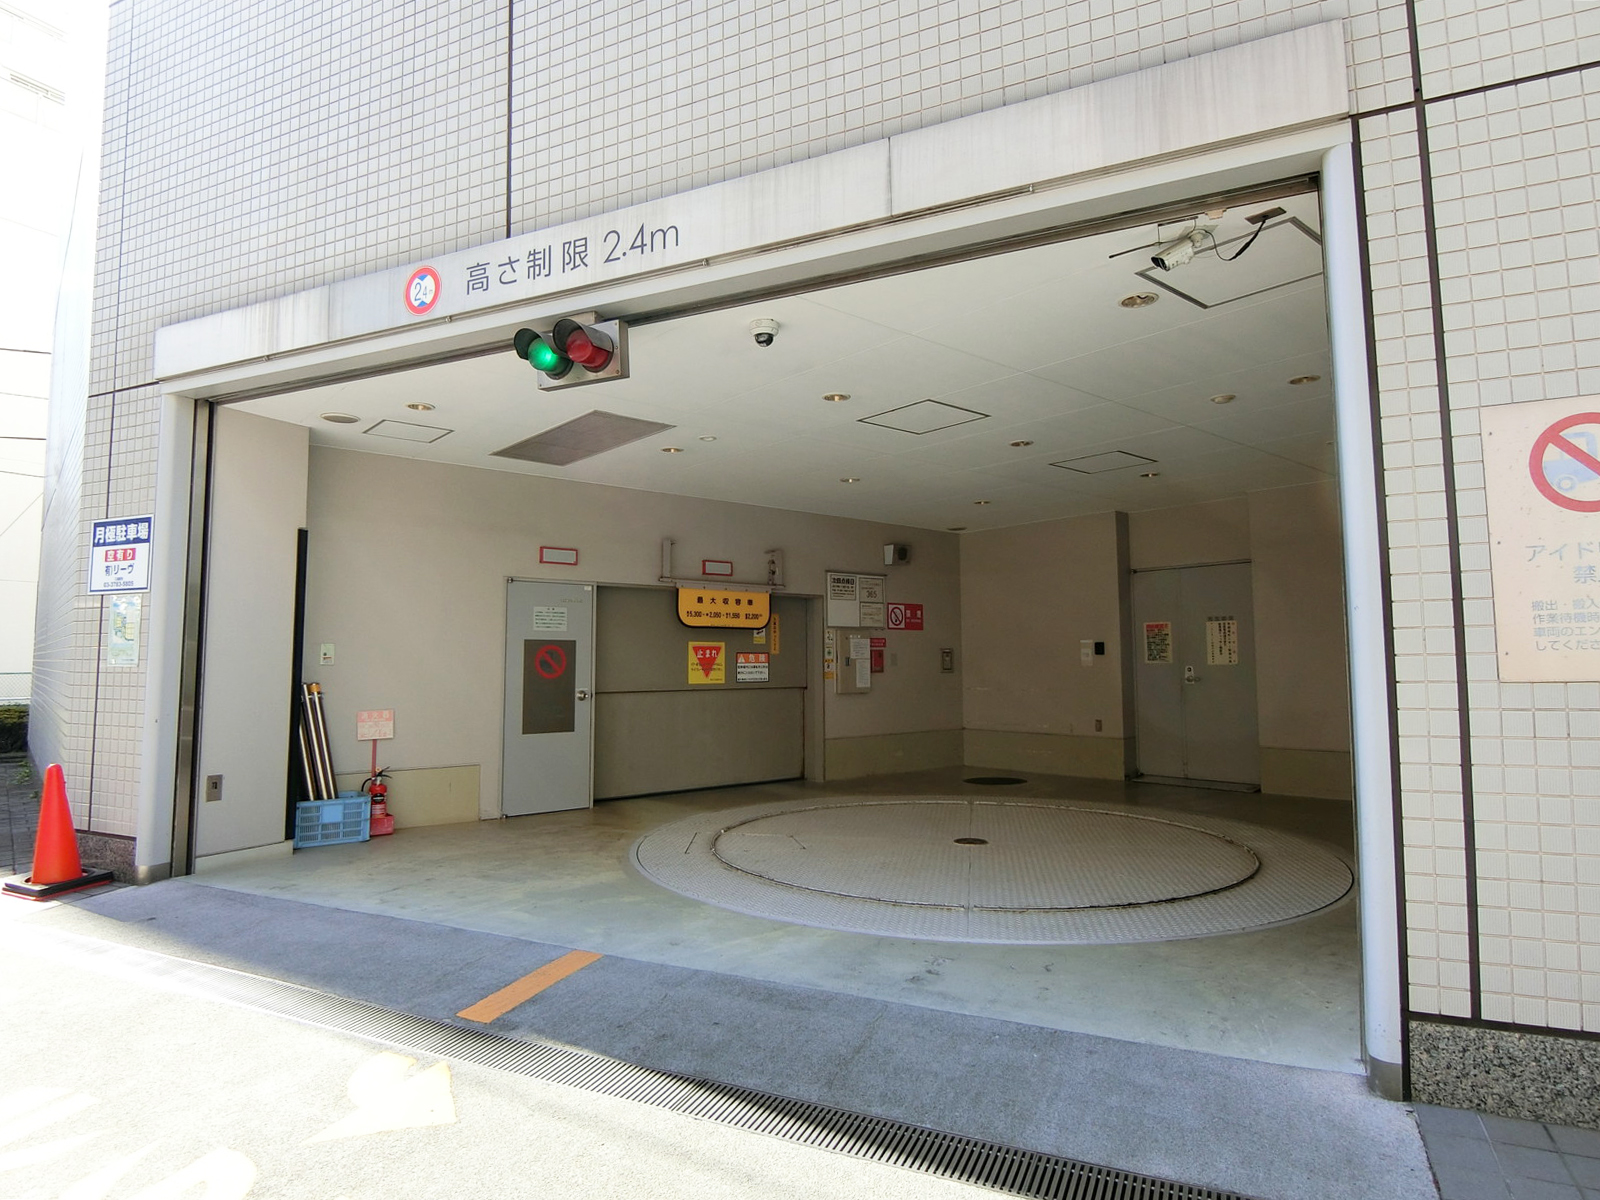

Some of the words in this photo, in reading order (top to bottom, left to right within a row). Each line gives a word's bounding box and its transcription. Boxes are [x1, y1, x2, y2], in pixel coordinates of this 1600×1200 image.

[466, 236, 588, 296] 高さ制限
[603, 222, 680, 264] 2.4m
[95, 523, 149, 543] 月極駐車場
[106, 550, 134, 562] 空有り
[1525, 541, 1600, 562] アイド
[1572, 565, 1600, 584] 禁
[1532, 611, 1600, 625] 作業待機時
[696, 649, 718, 659] 止まれ
